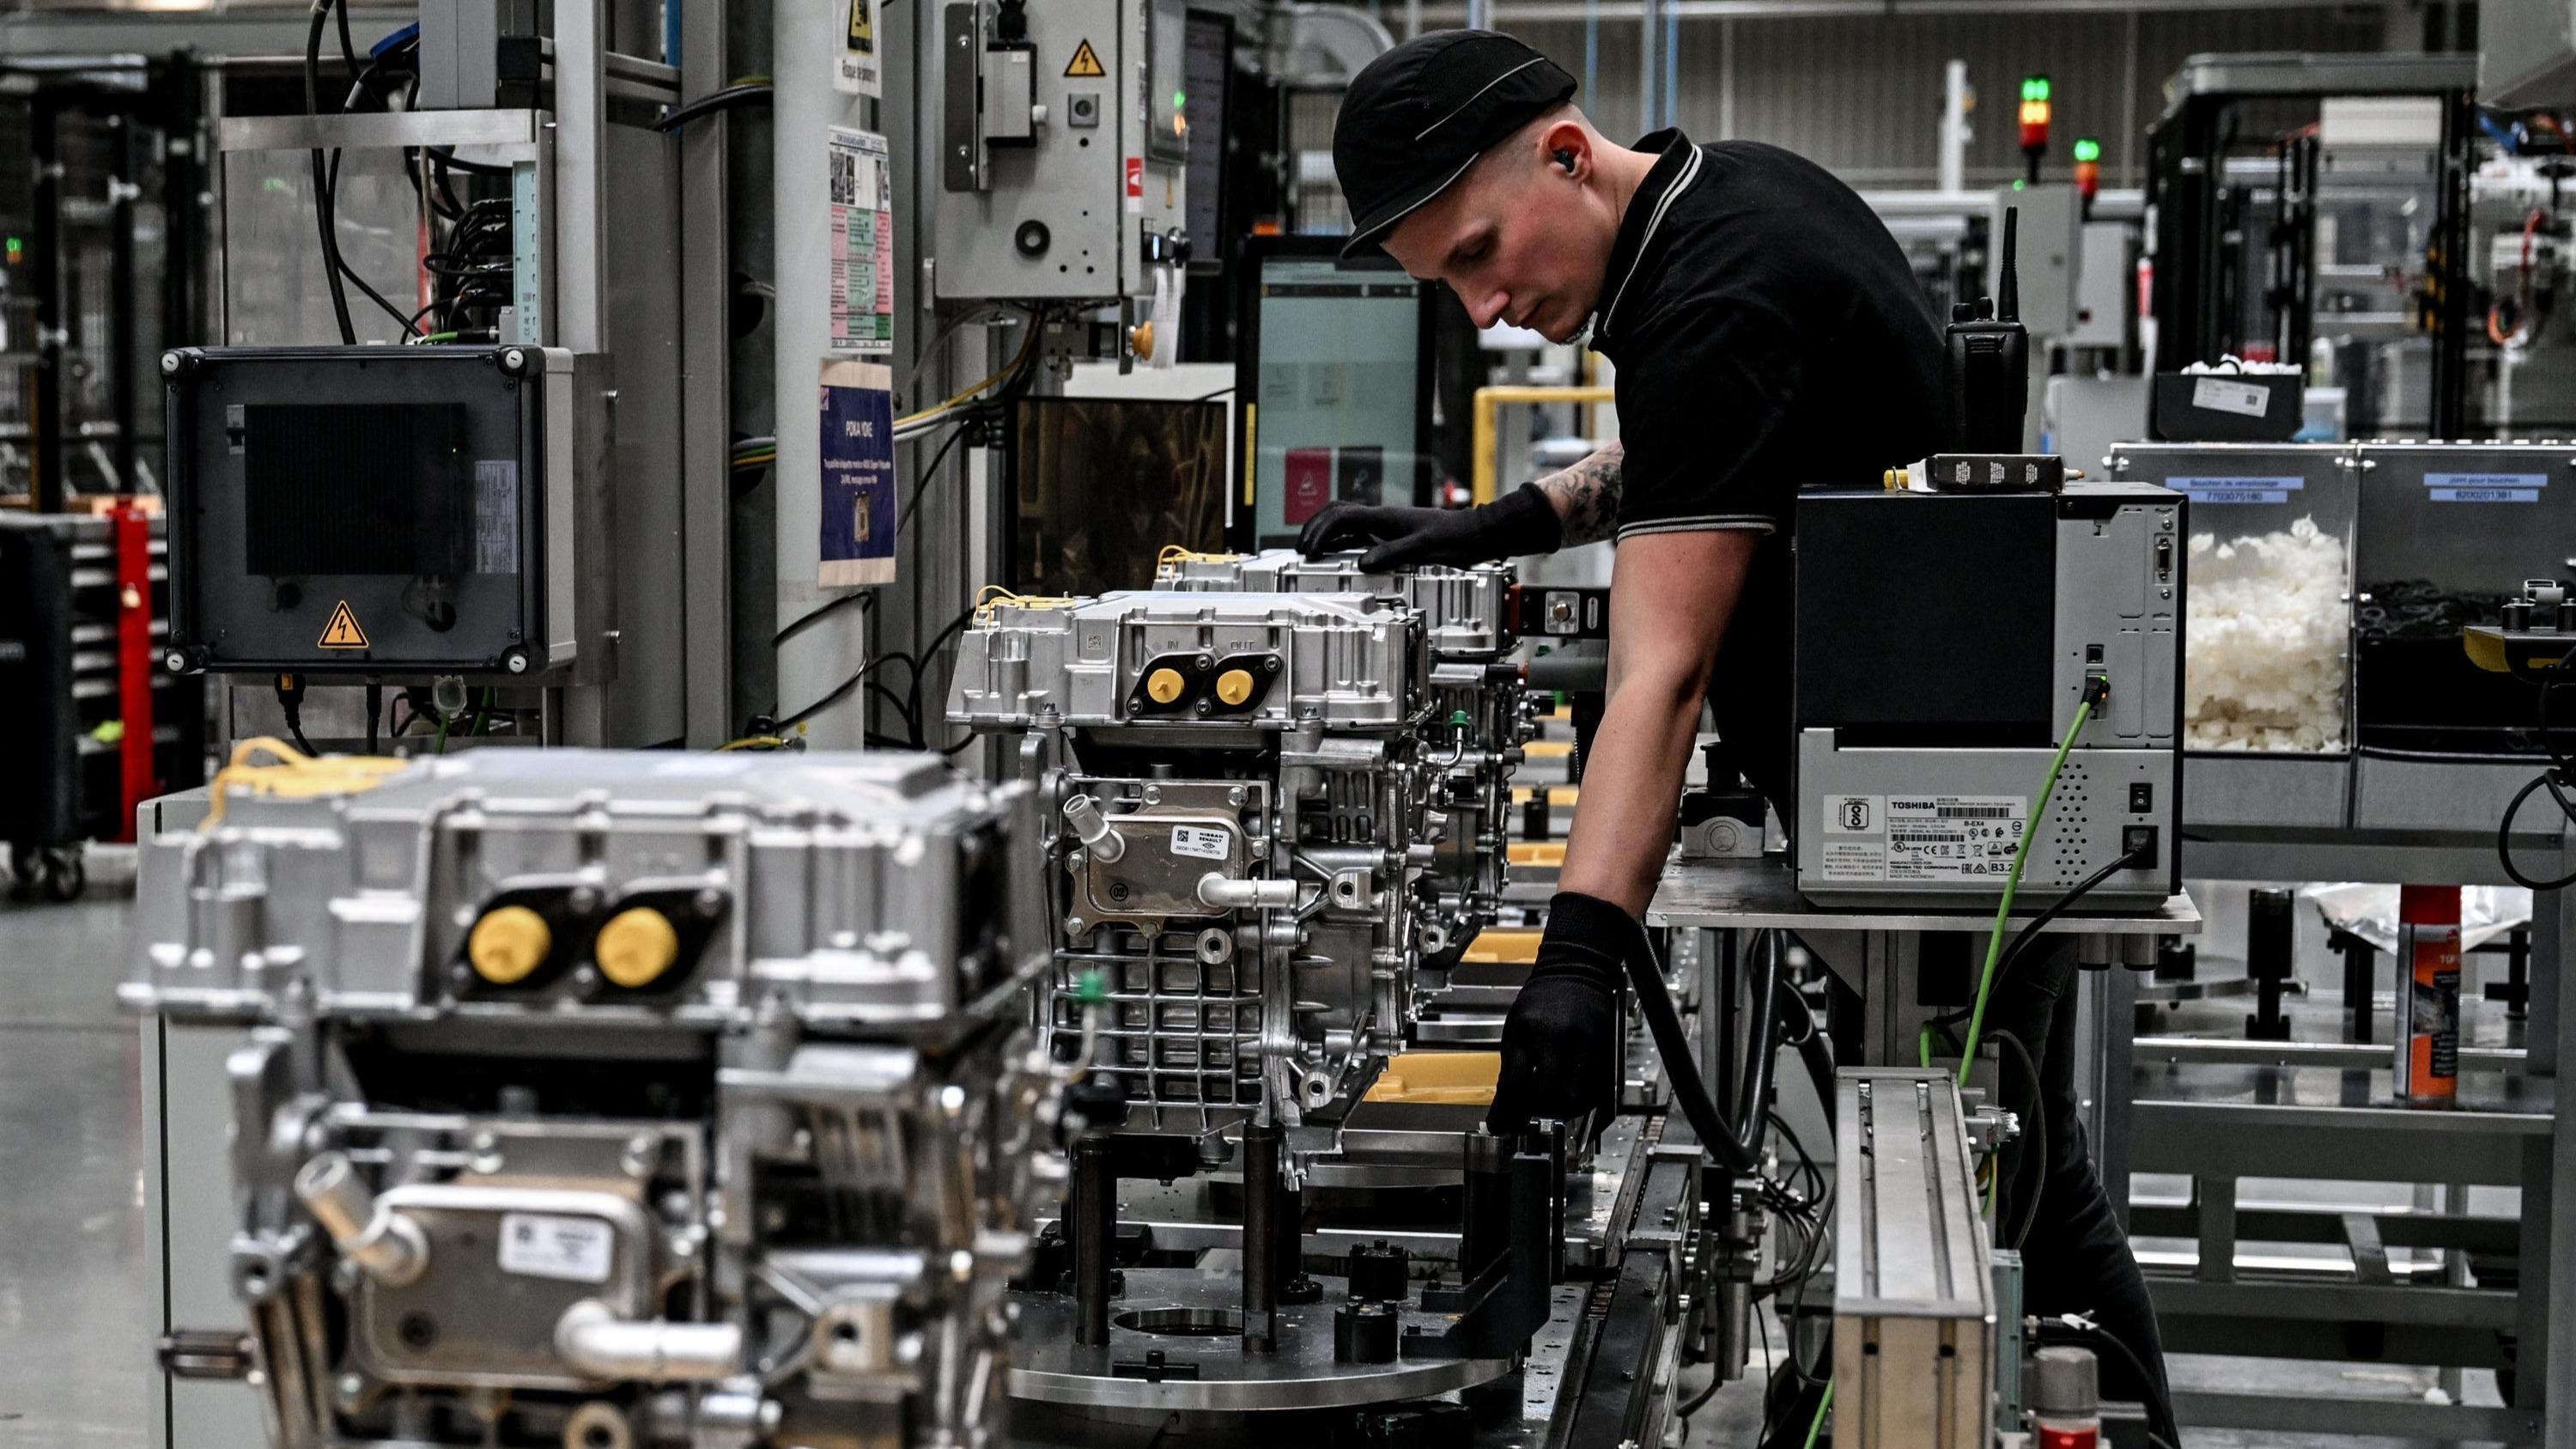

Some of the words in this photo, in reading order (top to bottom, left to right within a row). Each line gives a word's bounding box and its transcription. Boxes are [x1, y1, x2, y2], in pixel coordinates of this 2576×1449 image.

[1168, 640, 1179, 650] IN
[1230, 640, 1255, 650] OUT
[1114, 887, 1125, 898] 02
